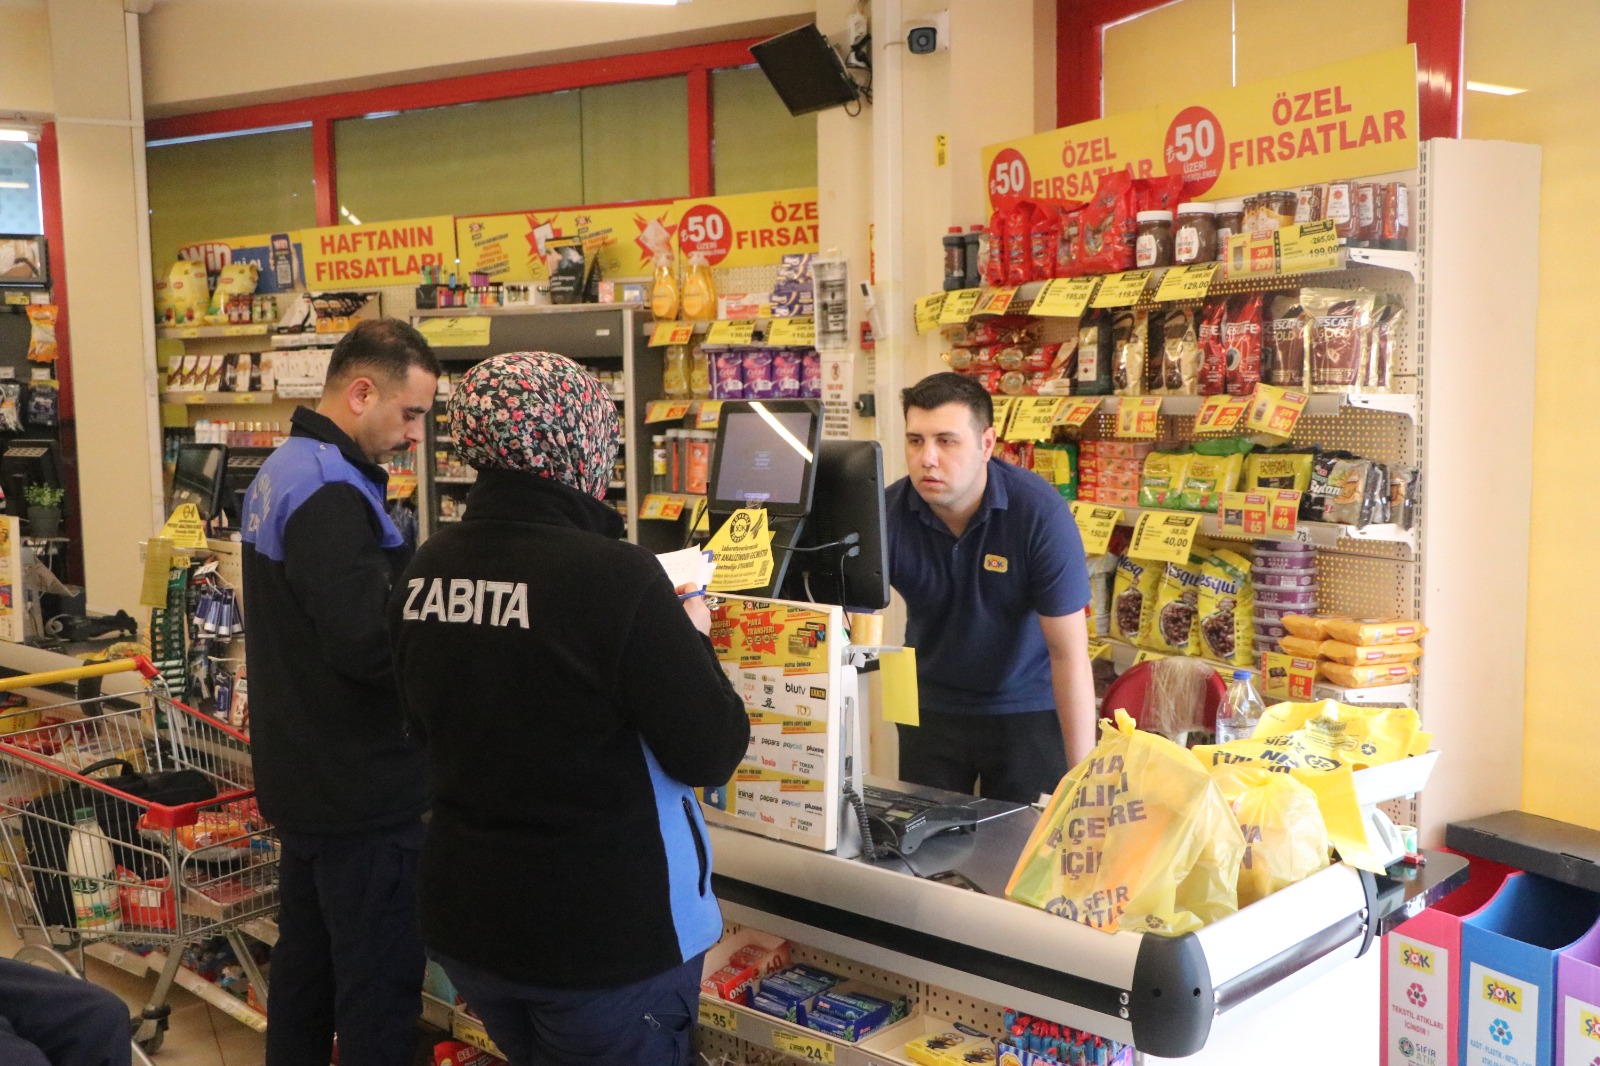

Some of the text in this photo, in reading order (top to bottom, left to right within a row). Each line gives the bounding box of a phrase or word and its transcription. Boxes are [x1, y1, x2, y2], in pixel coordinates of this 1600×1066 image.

[1272, 85, 1352, 126] ÖZEL
[1229, 109, 1408, 170] FIRSATLAR
[1062, 137, 1117, 168] ÖZEL
[771, 201, 818, 223] ÖZE
[320, 226, 434, 256] HAFTANIN
[736, 224, 818, 249] FIRSAT
[316, 253, 443, 282] FIRSATLARI
[1164, 537, 1188, 548] 40,00
[1297, 530, 1307, 542] 73
[1118, 555, 1144, 577] Nesq
[1200, 573, 1237, 594] esqui
[403, 577, 530, 629] ZABITA
[785, 683, 806, 695] blutv
[761, 738, 780, 747] papara
[760, 794, 778, 804] papara
[1404, 949, 1430, 969] ŞOK
[1487, 983, 1517, 1005] ŞOK
[712, 1013, 727, 1028] 35
[806, 1045, 823, 1061] 24
[1415, 1043, 1436, 1057] SIFIR
